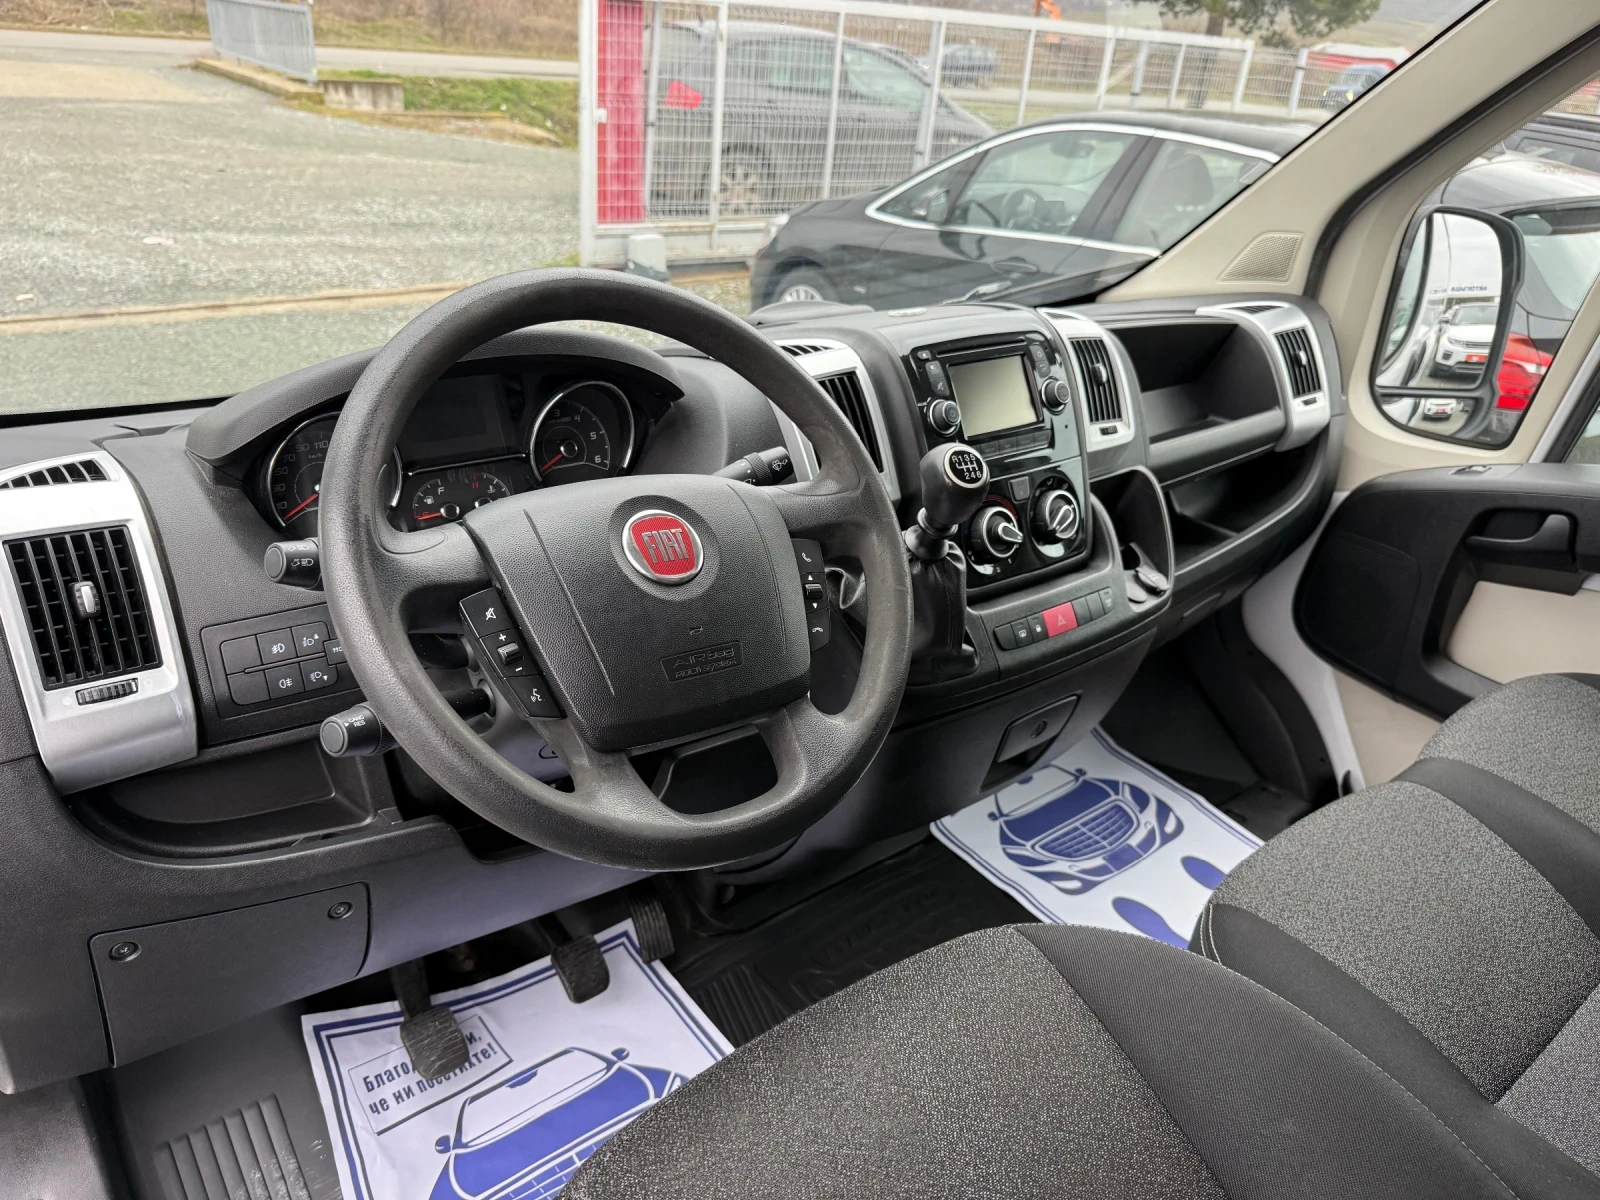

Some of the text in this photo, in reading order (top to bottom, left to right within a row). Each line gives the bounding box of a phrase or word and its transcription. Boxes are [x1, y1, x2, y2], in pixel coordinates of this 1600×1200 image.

[573, 414, 581, 423] 4
[589, 431, 597, 440] 5
[295, 440, 329, 452] 90 110
[283, 453, 296, 462] 70
[594, 455, 602, 464] 6
[951, 455, 959, 463] R
[969, 453, 976, 461] 5
[274, 466, 289, 476] 50
[964, 472, 970, 480] 2
[976, 470, 982, 478] 6
[272, 483, 286, 492] 30
[472, 481, 480, 489] H
[437, 486, 445, 495] F
[276, 501, 288, 510] 10
[641, 528, 690, 564] FIAT
[353, 719, 366, 728] RES
[368, 1096, 390, 1115] че
[392, 1084, 415, 1105] ни
